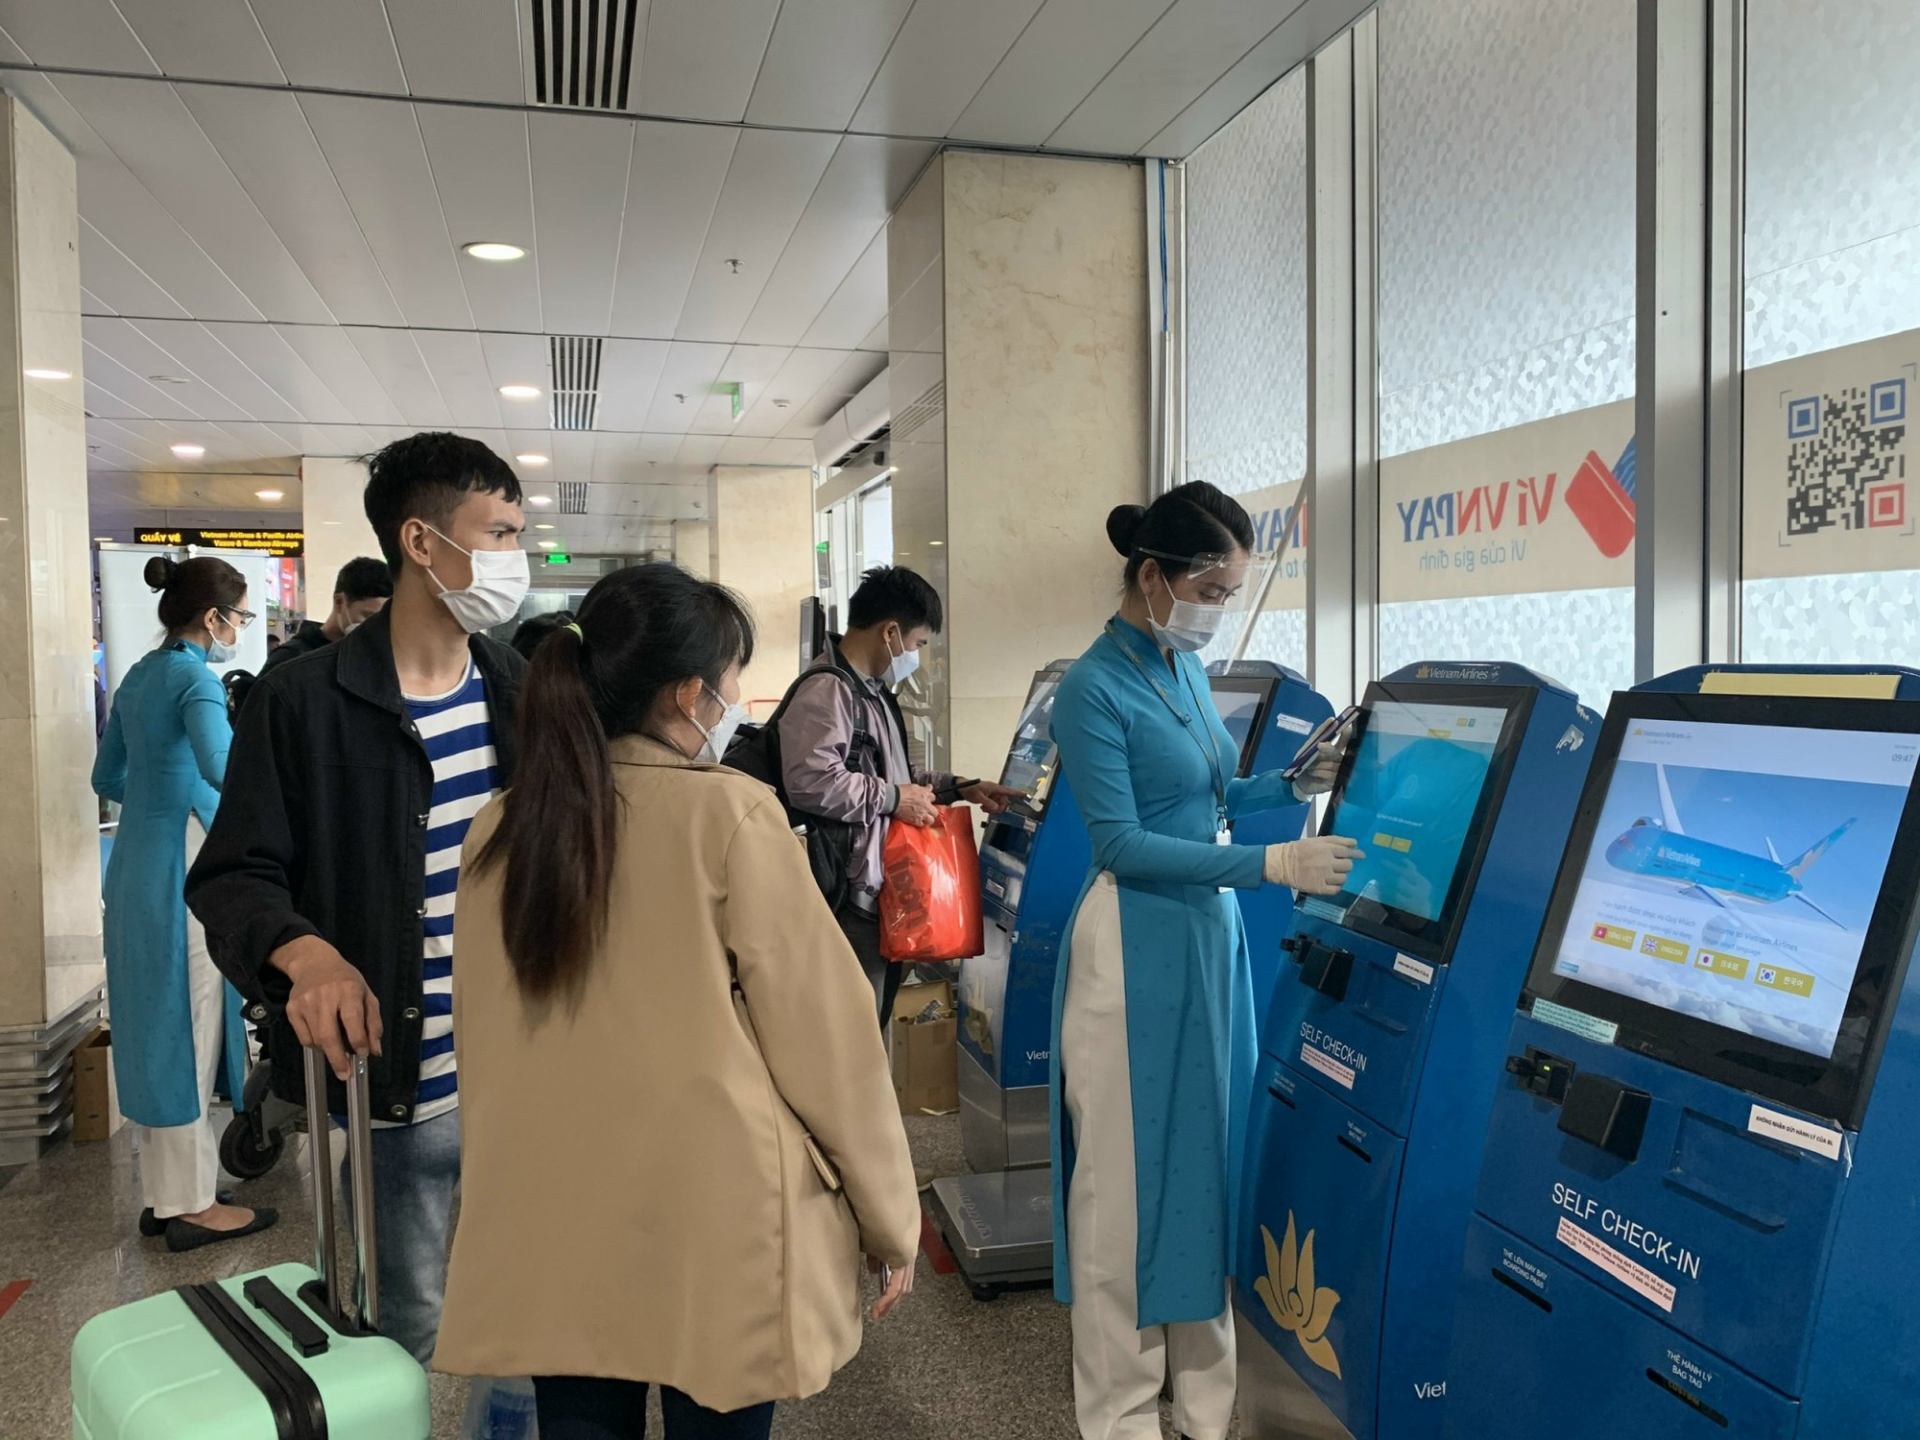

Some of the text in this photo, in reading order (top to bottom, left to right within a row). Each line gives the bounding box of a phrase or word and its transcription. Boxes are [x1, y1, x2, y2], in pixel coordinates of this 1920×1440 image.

[200, 531, 228, 539] Vietnam
[229, 531, 255, 539] Airlines
[272, 540, 299, 549] Airways
[1300, 1021, 1323, 1045] SELF
[1322, 1034, 1367, 1072] CHECK-IN
[1552, 1182, 1701, 1280] SELF CHECK-IN
[1672, 1364, 1703, 1389] BAG TAG
